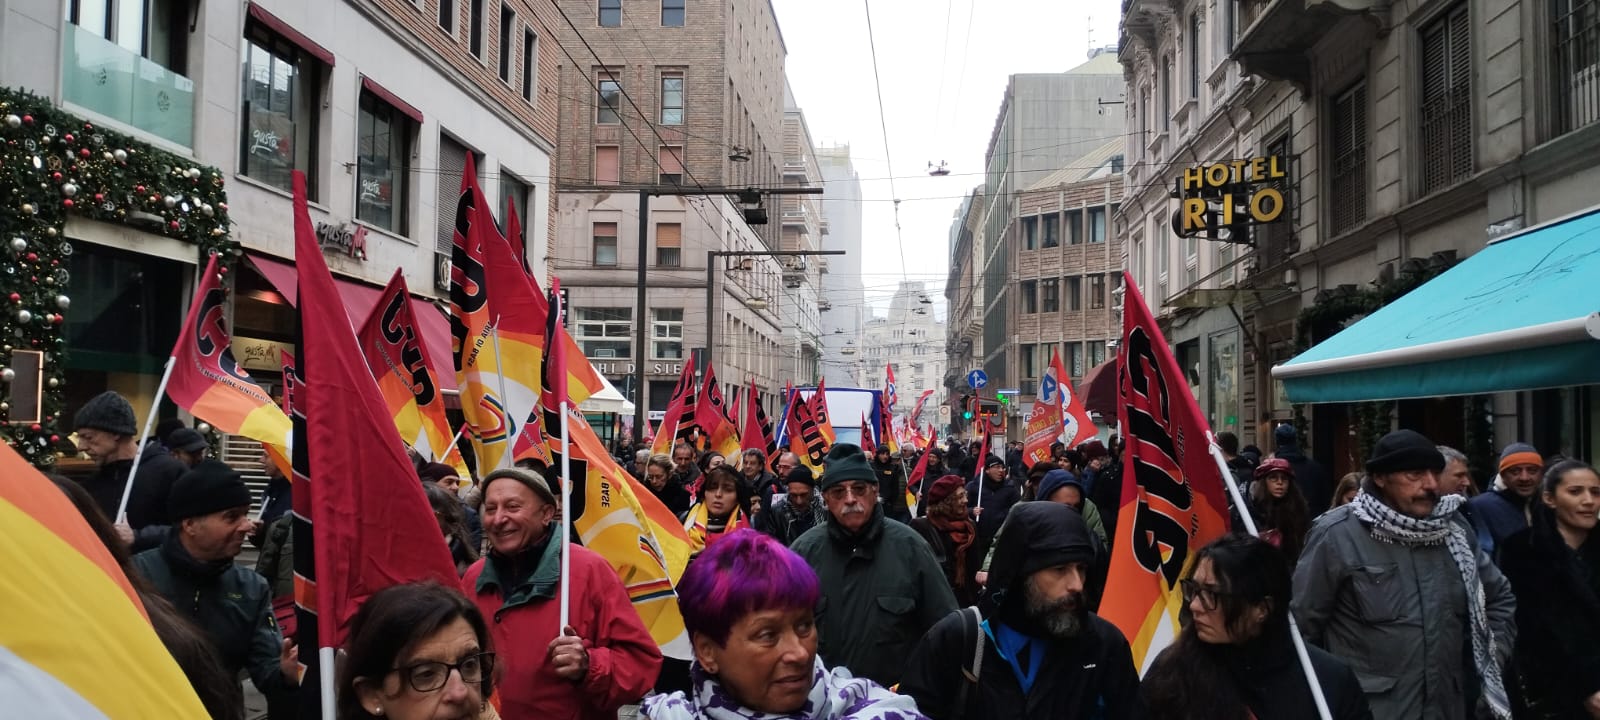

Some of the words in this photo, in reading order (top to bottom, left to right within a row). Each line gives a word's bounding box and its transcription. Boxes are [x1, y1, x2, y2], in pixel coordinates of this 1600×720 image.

[1184, 155, 1285, 190] HOTEL
[1184, 188, 1284, 231] RIO
[654, 363, 682, 374] SIE
[795, 397, 829, 466] CUB
